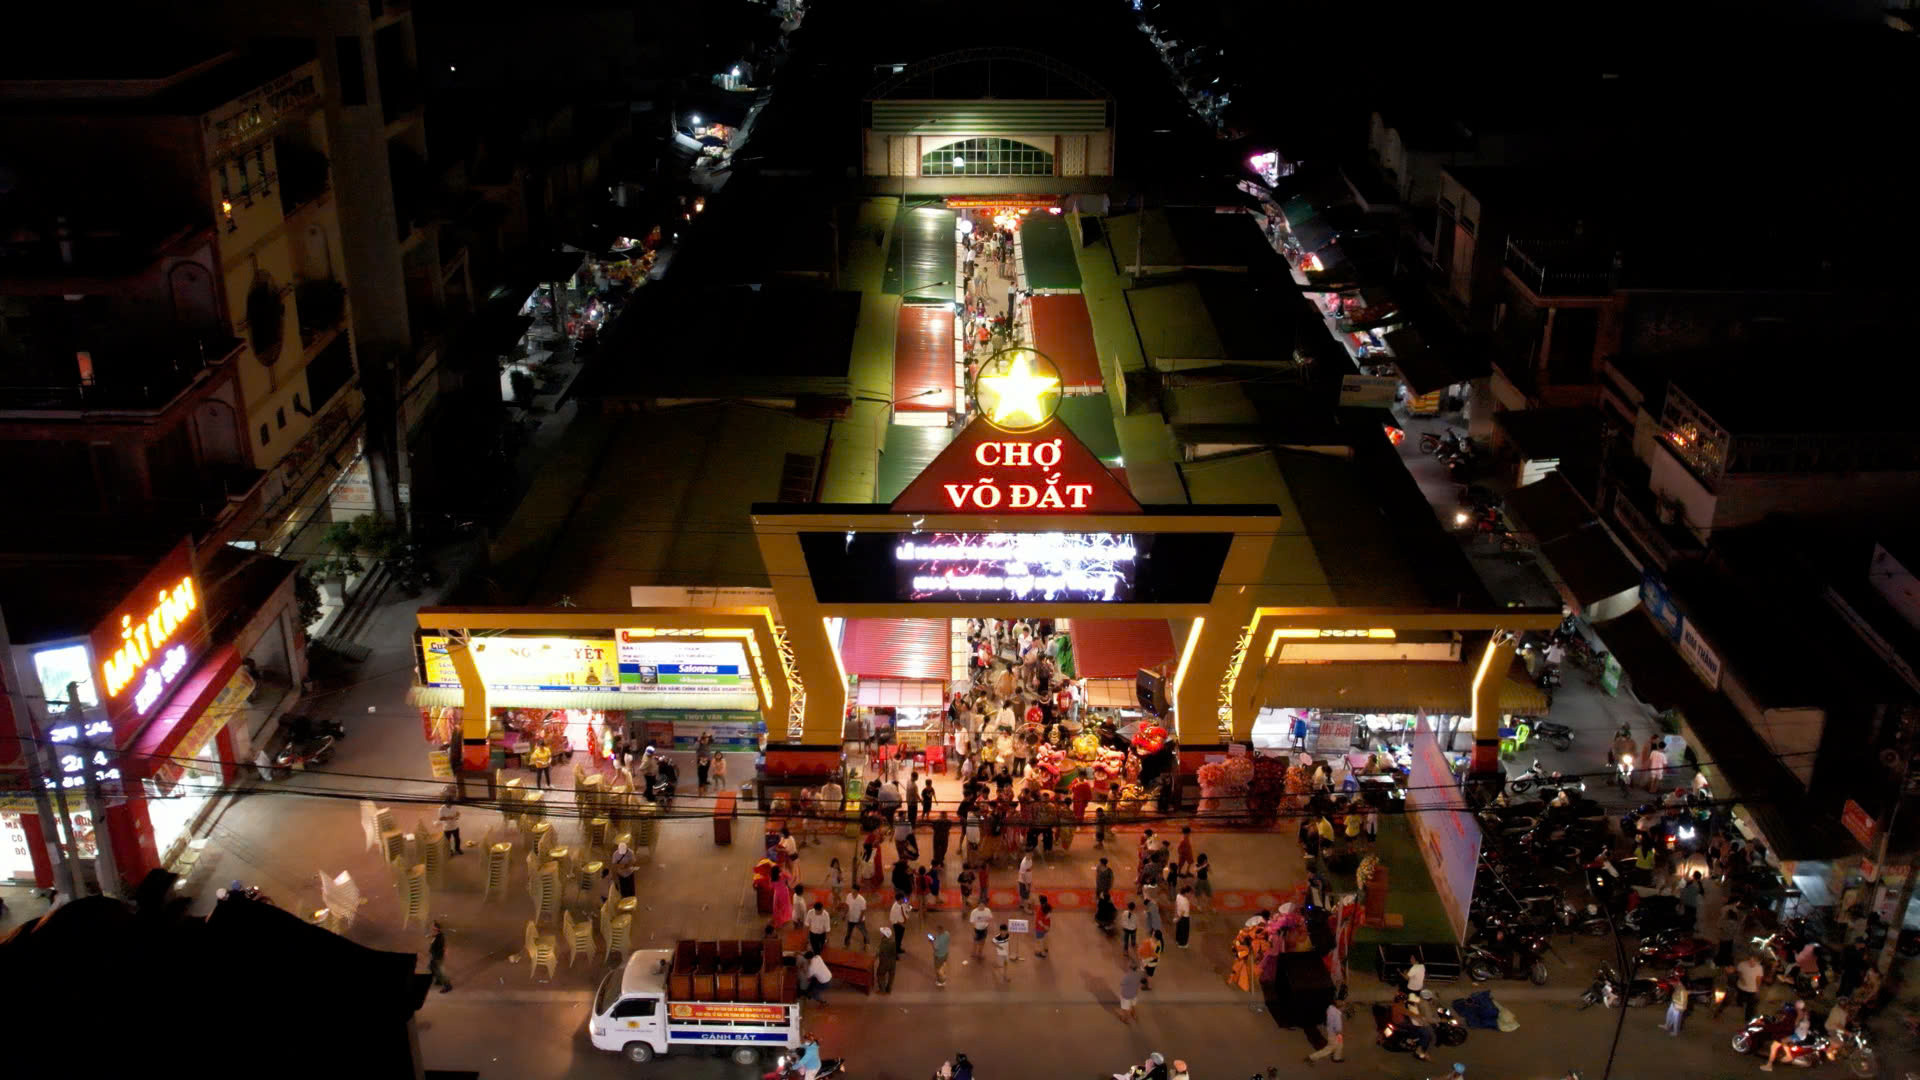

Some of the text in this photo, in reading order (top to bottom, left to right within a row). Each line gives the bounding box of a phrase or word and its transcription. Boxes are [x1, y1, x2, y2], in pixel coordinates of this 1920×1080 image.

[975, 438, 1062, 472] CHỢ
[944, 471, 1093, 509] VÕ ĐẮT
[678, 664, 718, 674] Salonpas
